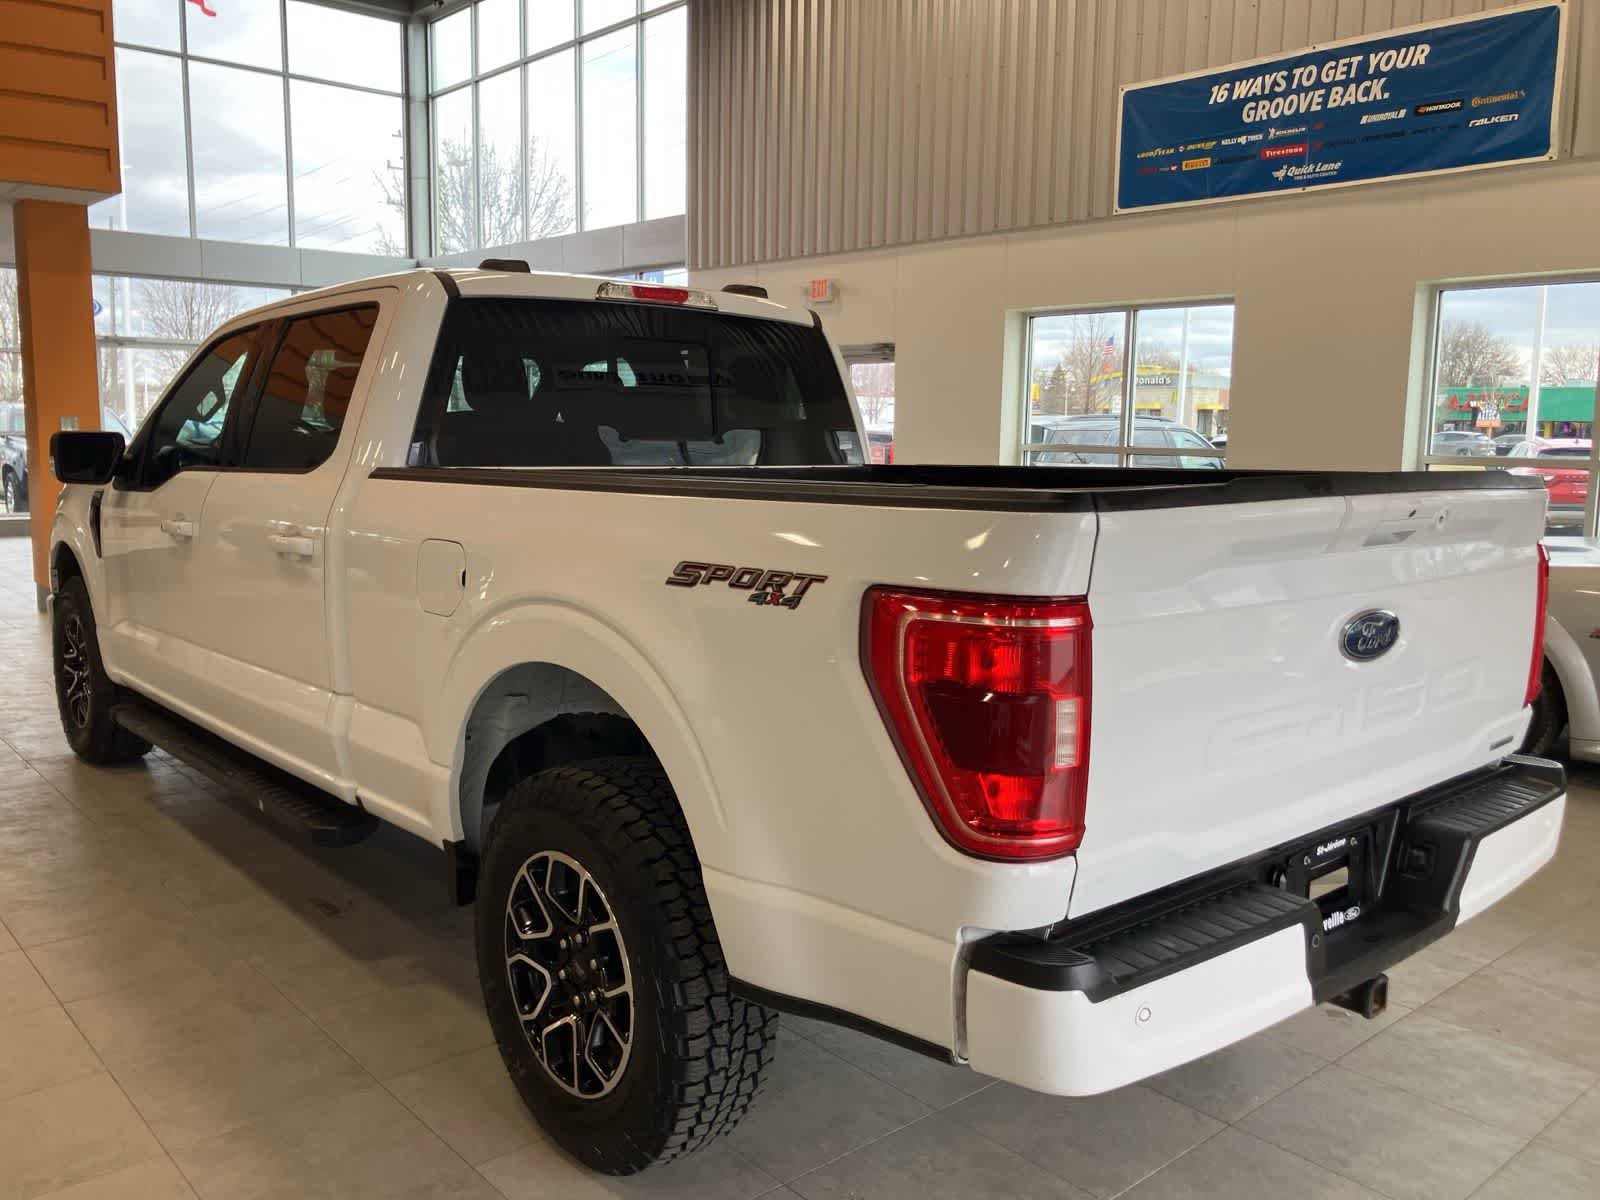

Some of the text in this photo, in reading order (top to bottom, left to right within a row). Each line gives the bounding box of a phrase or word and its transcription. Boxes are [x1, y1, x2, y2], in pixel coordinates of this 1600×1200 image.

[1209, 44, 1430, 104] 16 WAYS TO GET YOUR
[1242, 77, 1390, 123] GROOVE BACK.
[1286, 160, 1341, 177] Quick Lane
[1134, 374, 1173, 386] onald's
[665, 560, 828, 597] SPORT
